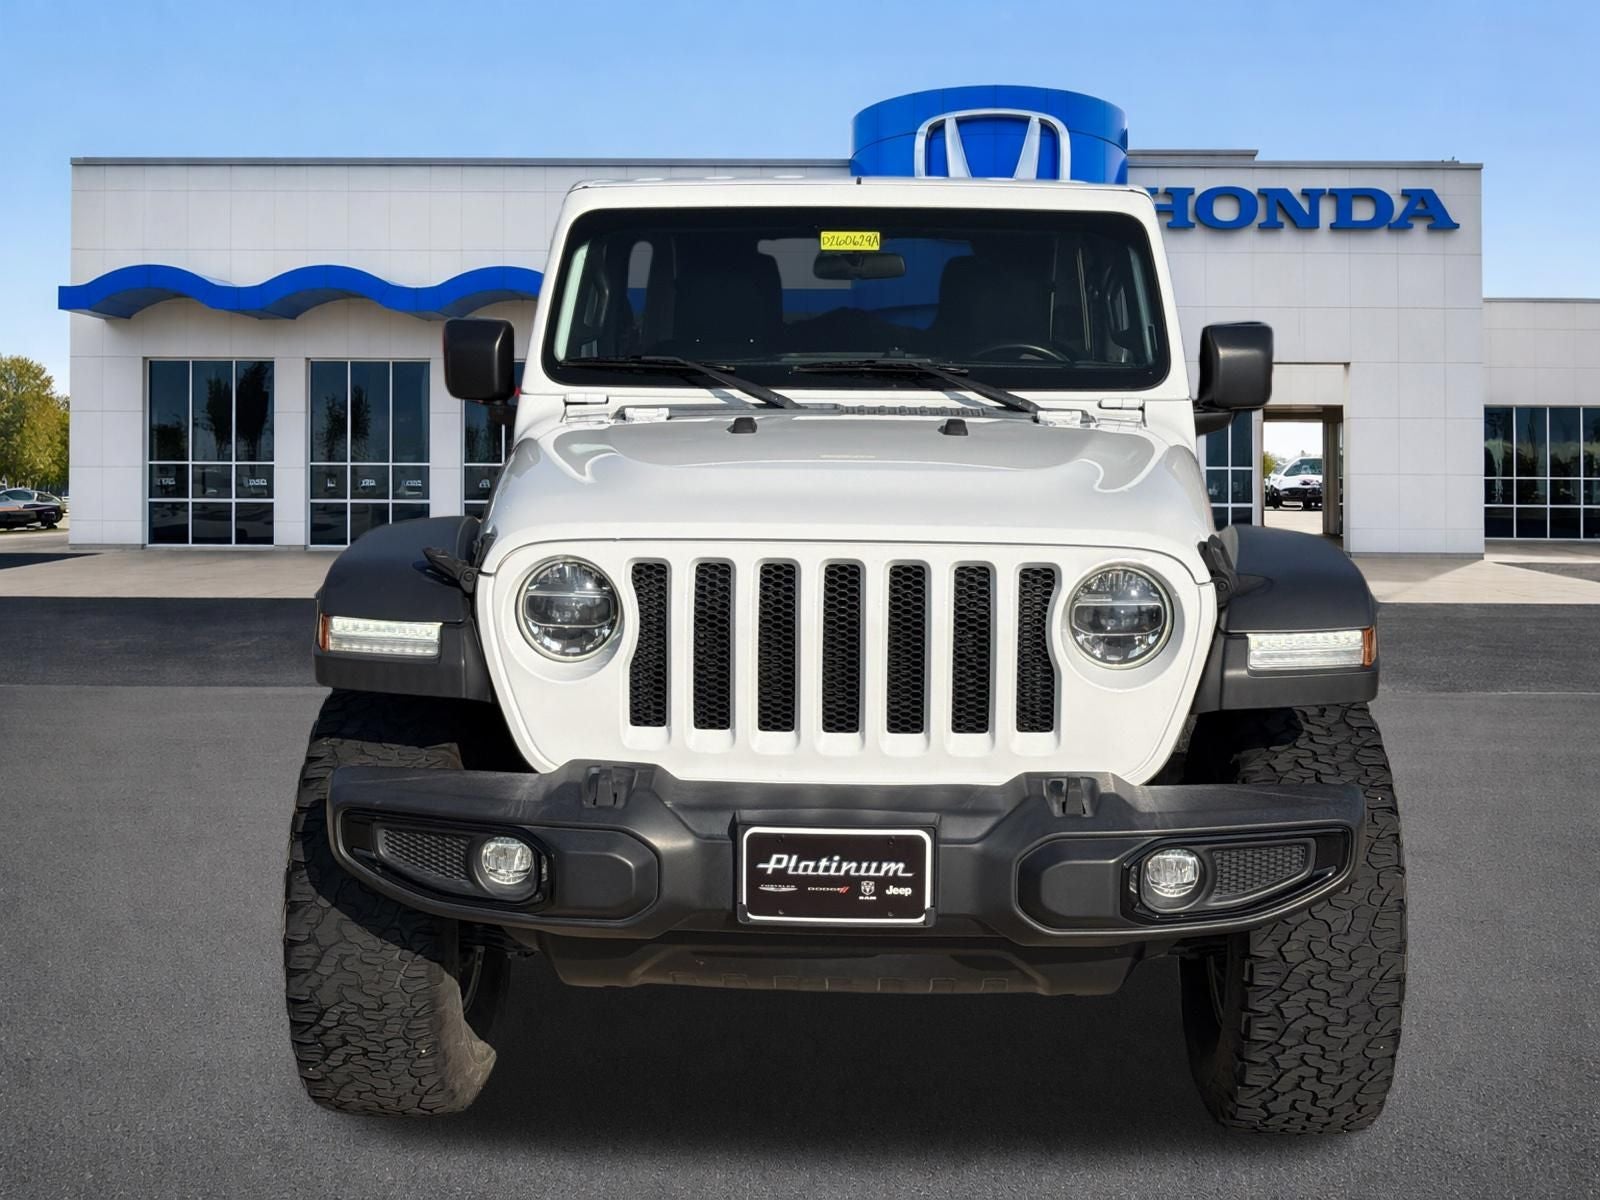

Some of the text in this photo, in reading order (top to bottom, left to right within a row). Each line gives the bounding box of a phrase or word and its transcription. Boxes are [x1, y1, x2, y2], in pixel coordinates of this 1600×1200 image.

[1145, 186, 1460, 230] HONDA
[756, 853, 914, 877] Platinum
[885, 885, 912, 896] Jeep
